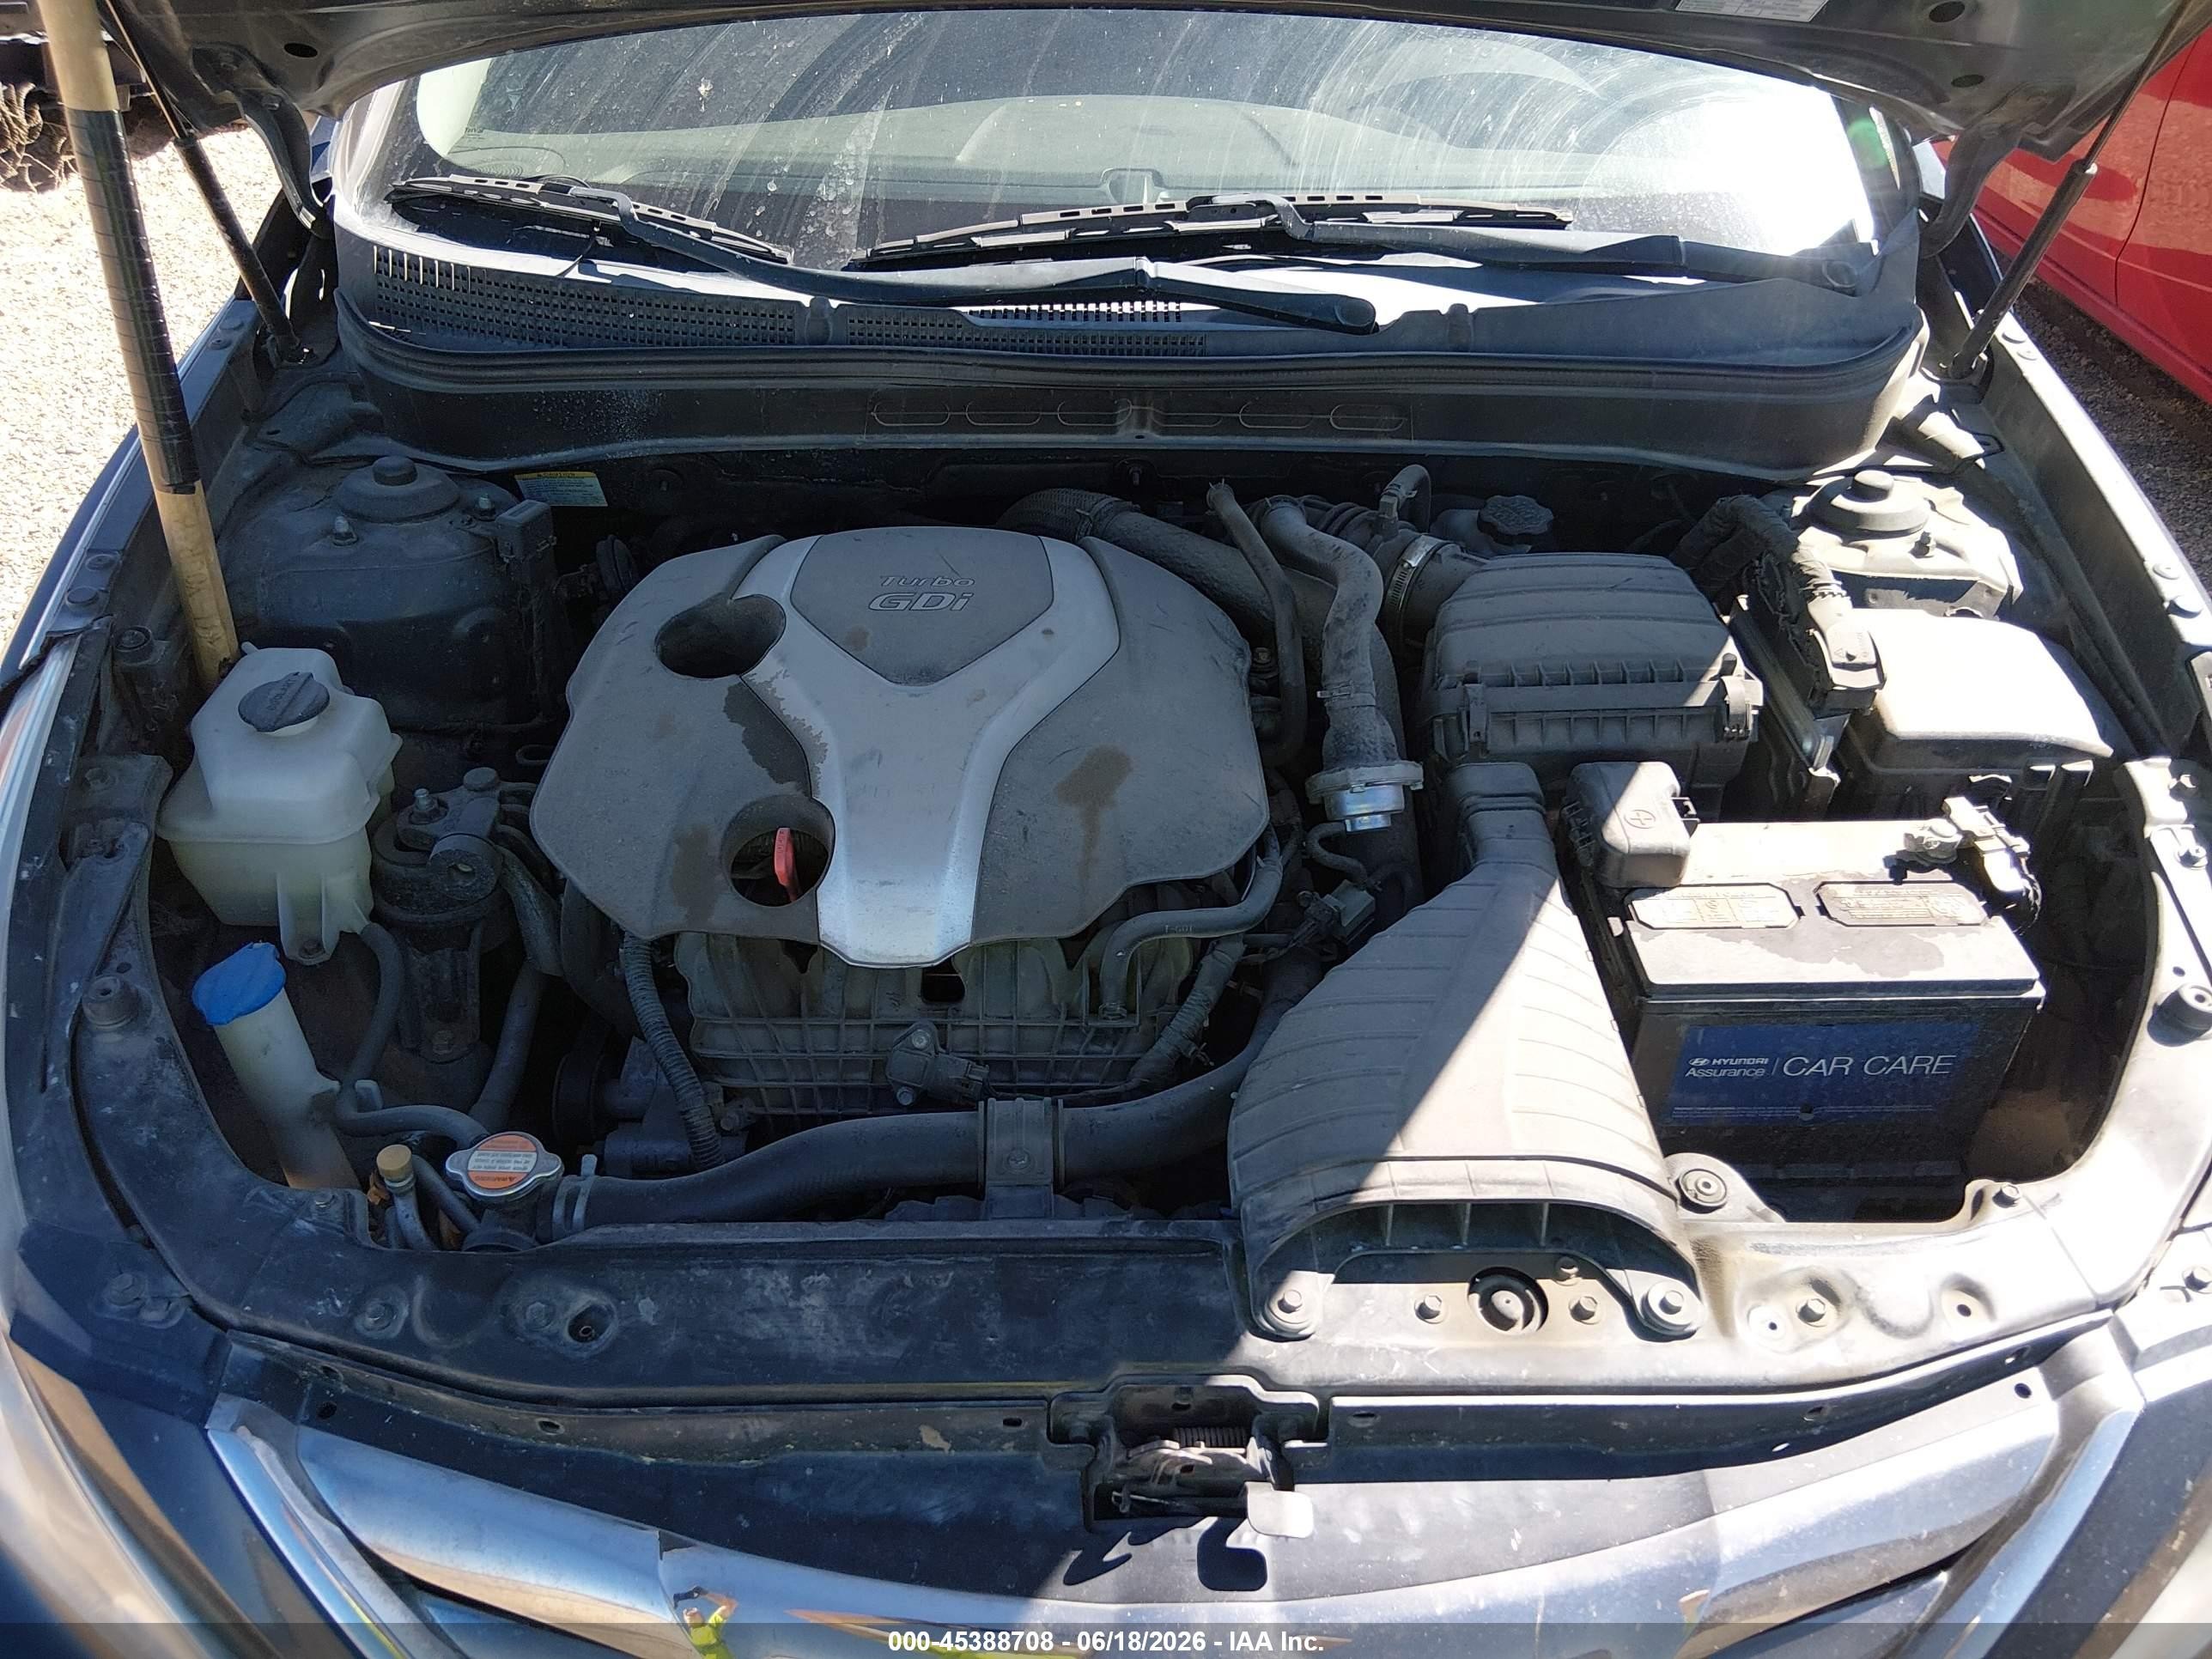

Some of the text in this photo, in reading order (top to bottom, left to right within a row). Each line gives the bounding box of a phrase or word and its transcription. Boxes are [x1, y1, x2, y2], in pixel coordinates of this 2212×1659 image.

[879, 575, 975, 586] Turbo
[868, 592, 975, 611] GDi
[1711, 1057, 1769, 1066] HYUNDAI
[1783, 1054, 1957, 1077] CAR CARE
[1685, 1066, 1765, 1078] Assurance
